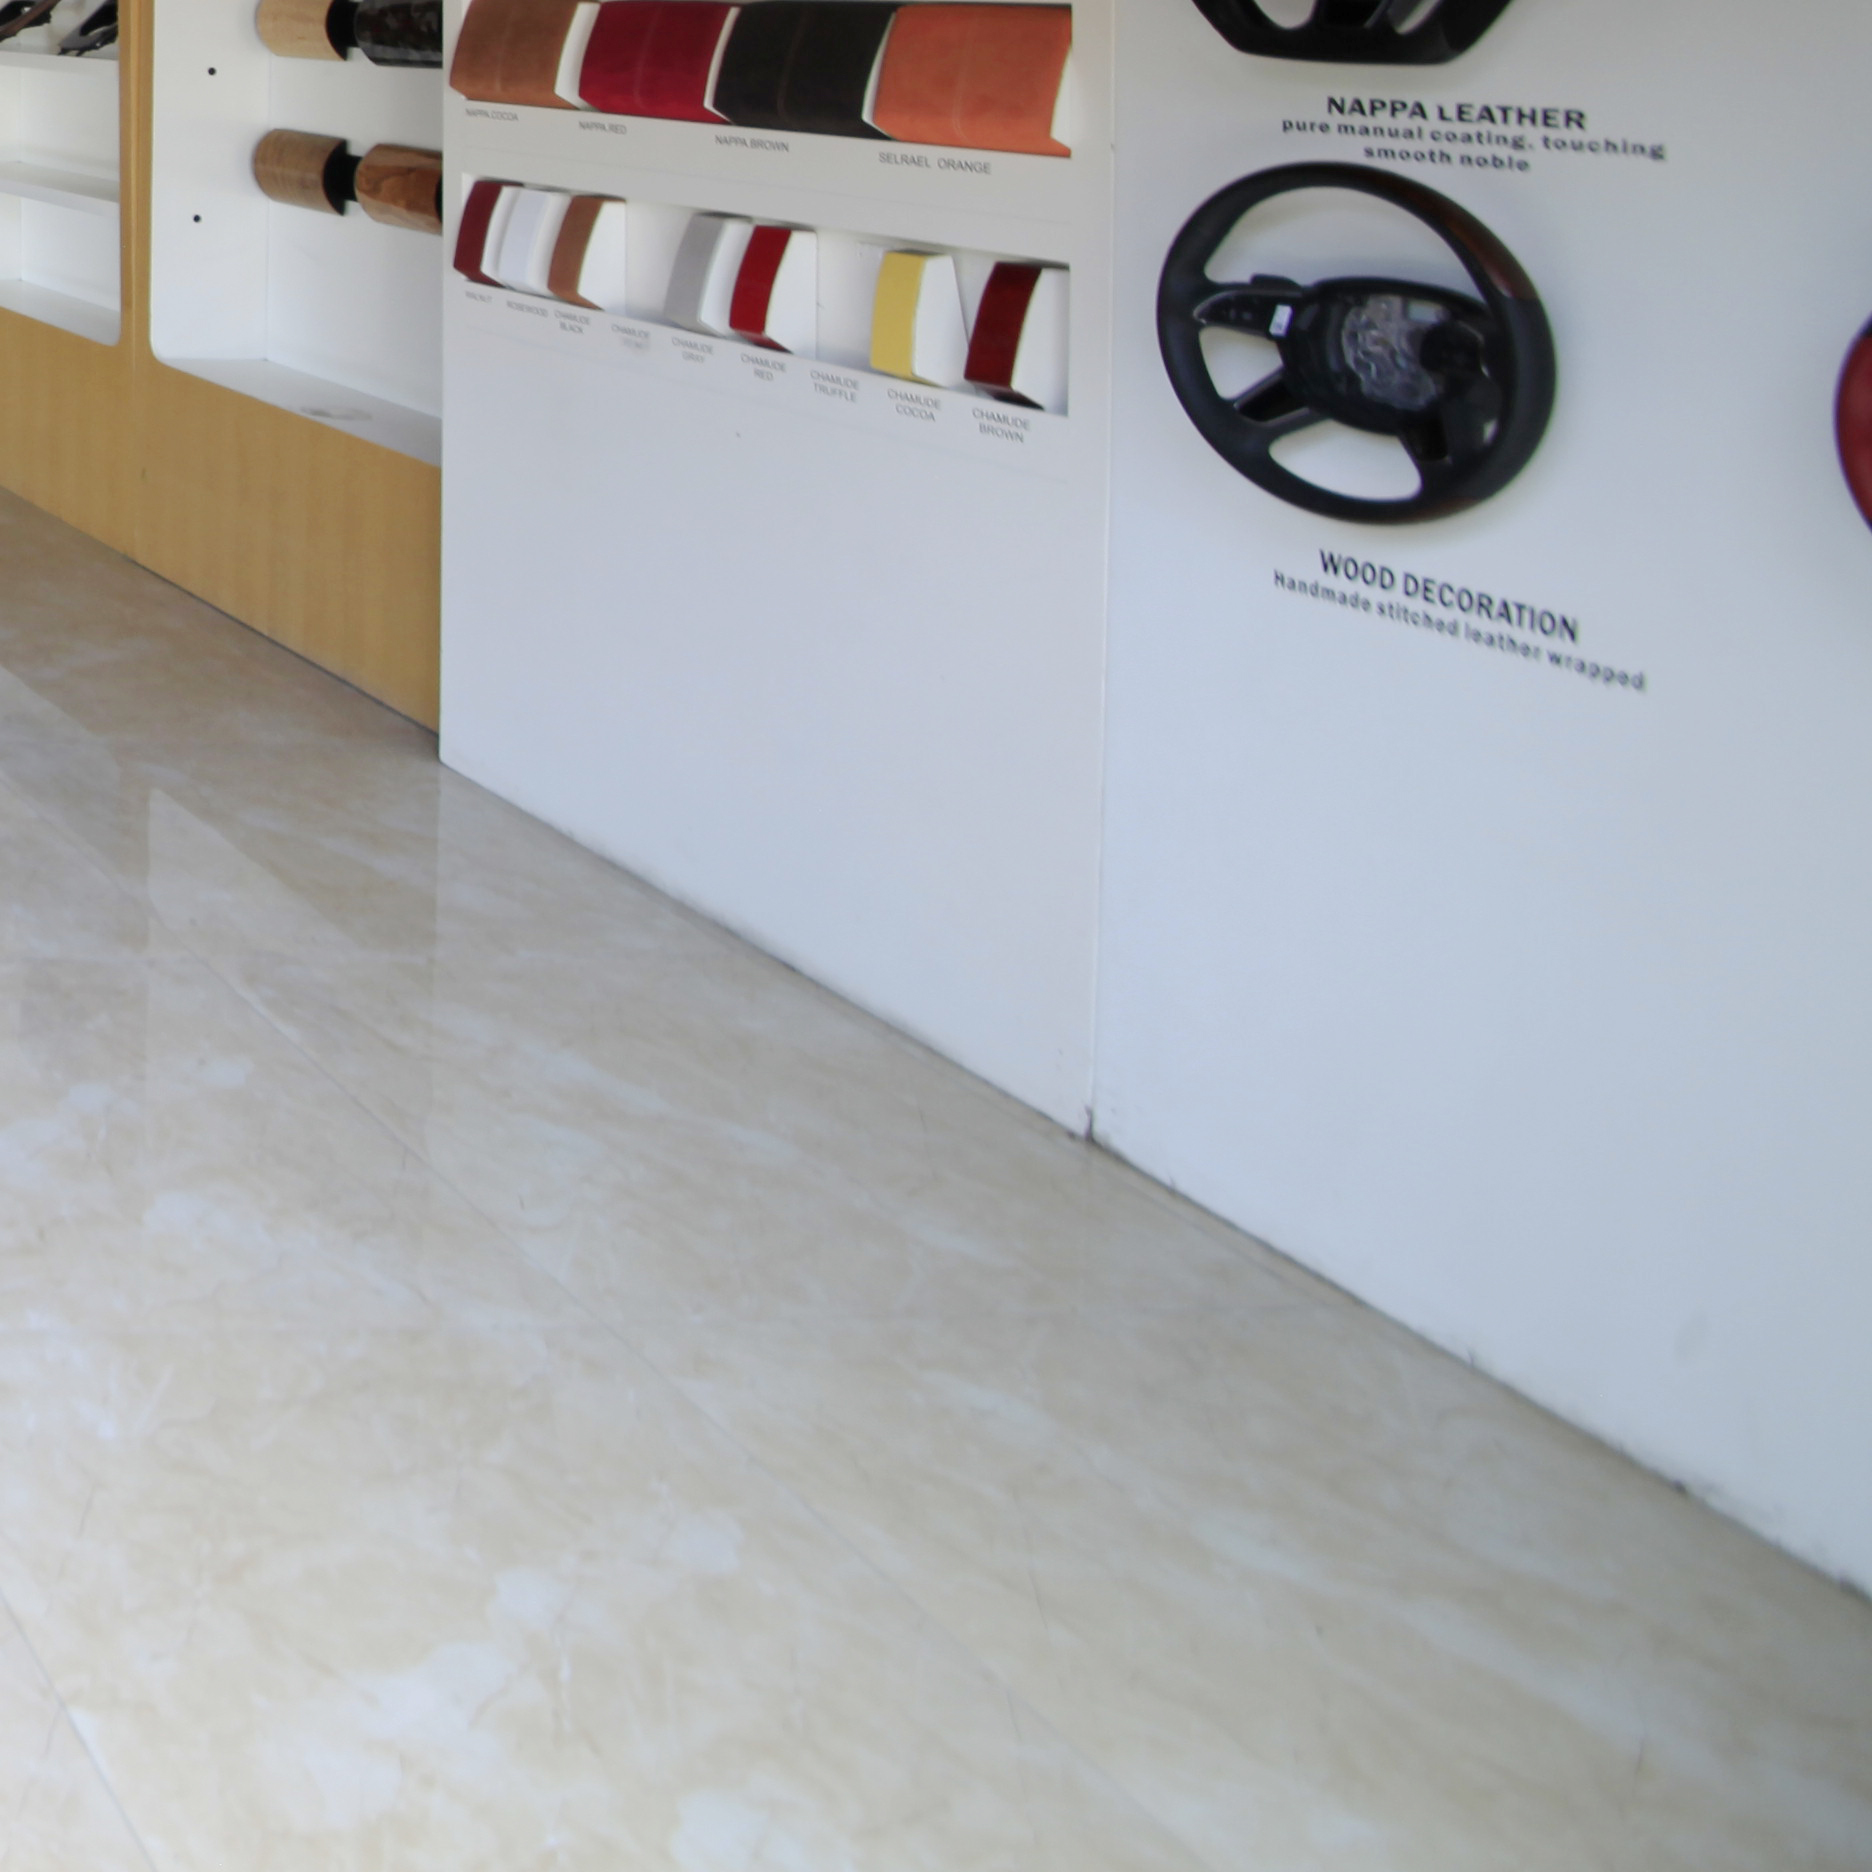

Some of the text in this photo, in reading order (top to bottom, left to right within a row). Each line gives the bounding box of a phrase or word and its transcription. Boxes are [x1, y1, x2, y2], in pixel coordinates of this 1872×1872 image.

[1327, 97, 1587, 130] NAPPA LEATHER
[1282, 119, 1331, 133] pure
[1337, 124, 1424, 141] manual
[879, 152, 991, 174] SELRAEL ORANGE
[1364, 146, 1530, 172] smooth noble
[895, 404, 936, 422] COCOA
[979, 422, 1024, 443] BROWN
[1319, 548, 1580, 643] WOOD DECORATION
[1273, 569, 1371, 613] Handmade
[1464, 621, 1540, 661] leather
[1547, 649, 1647, 692] wrapped
